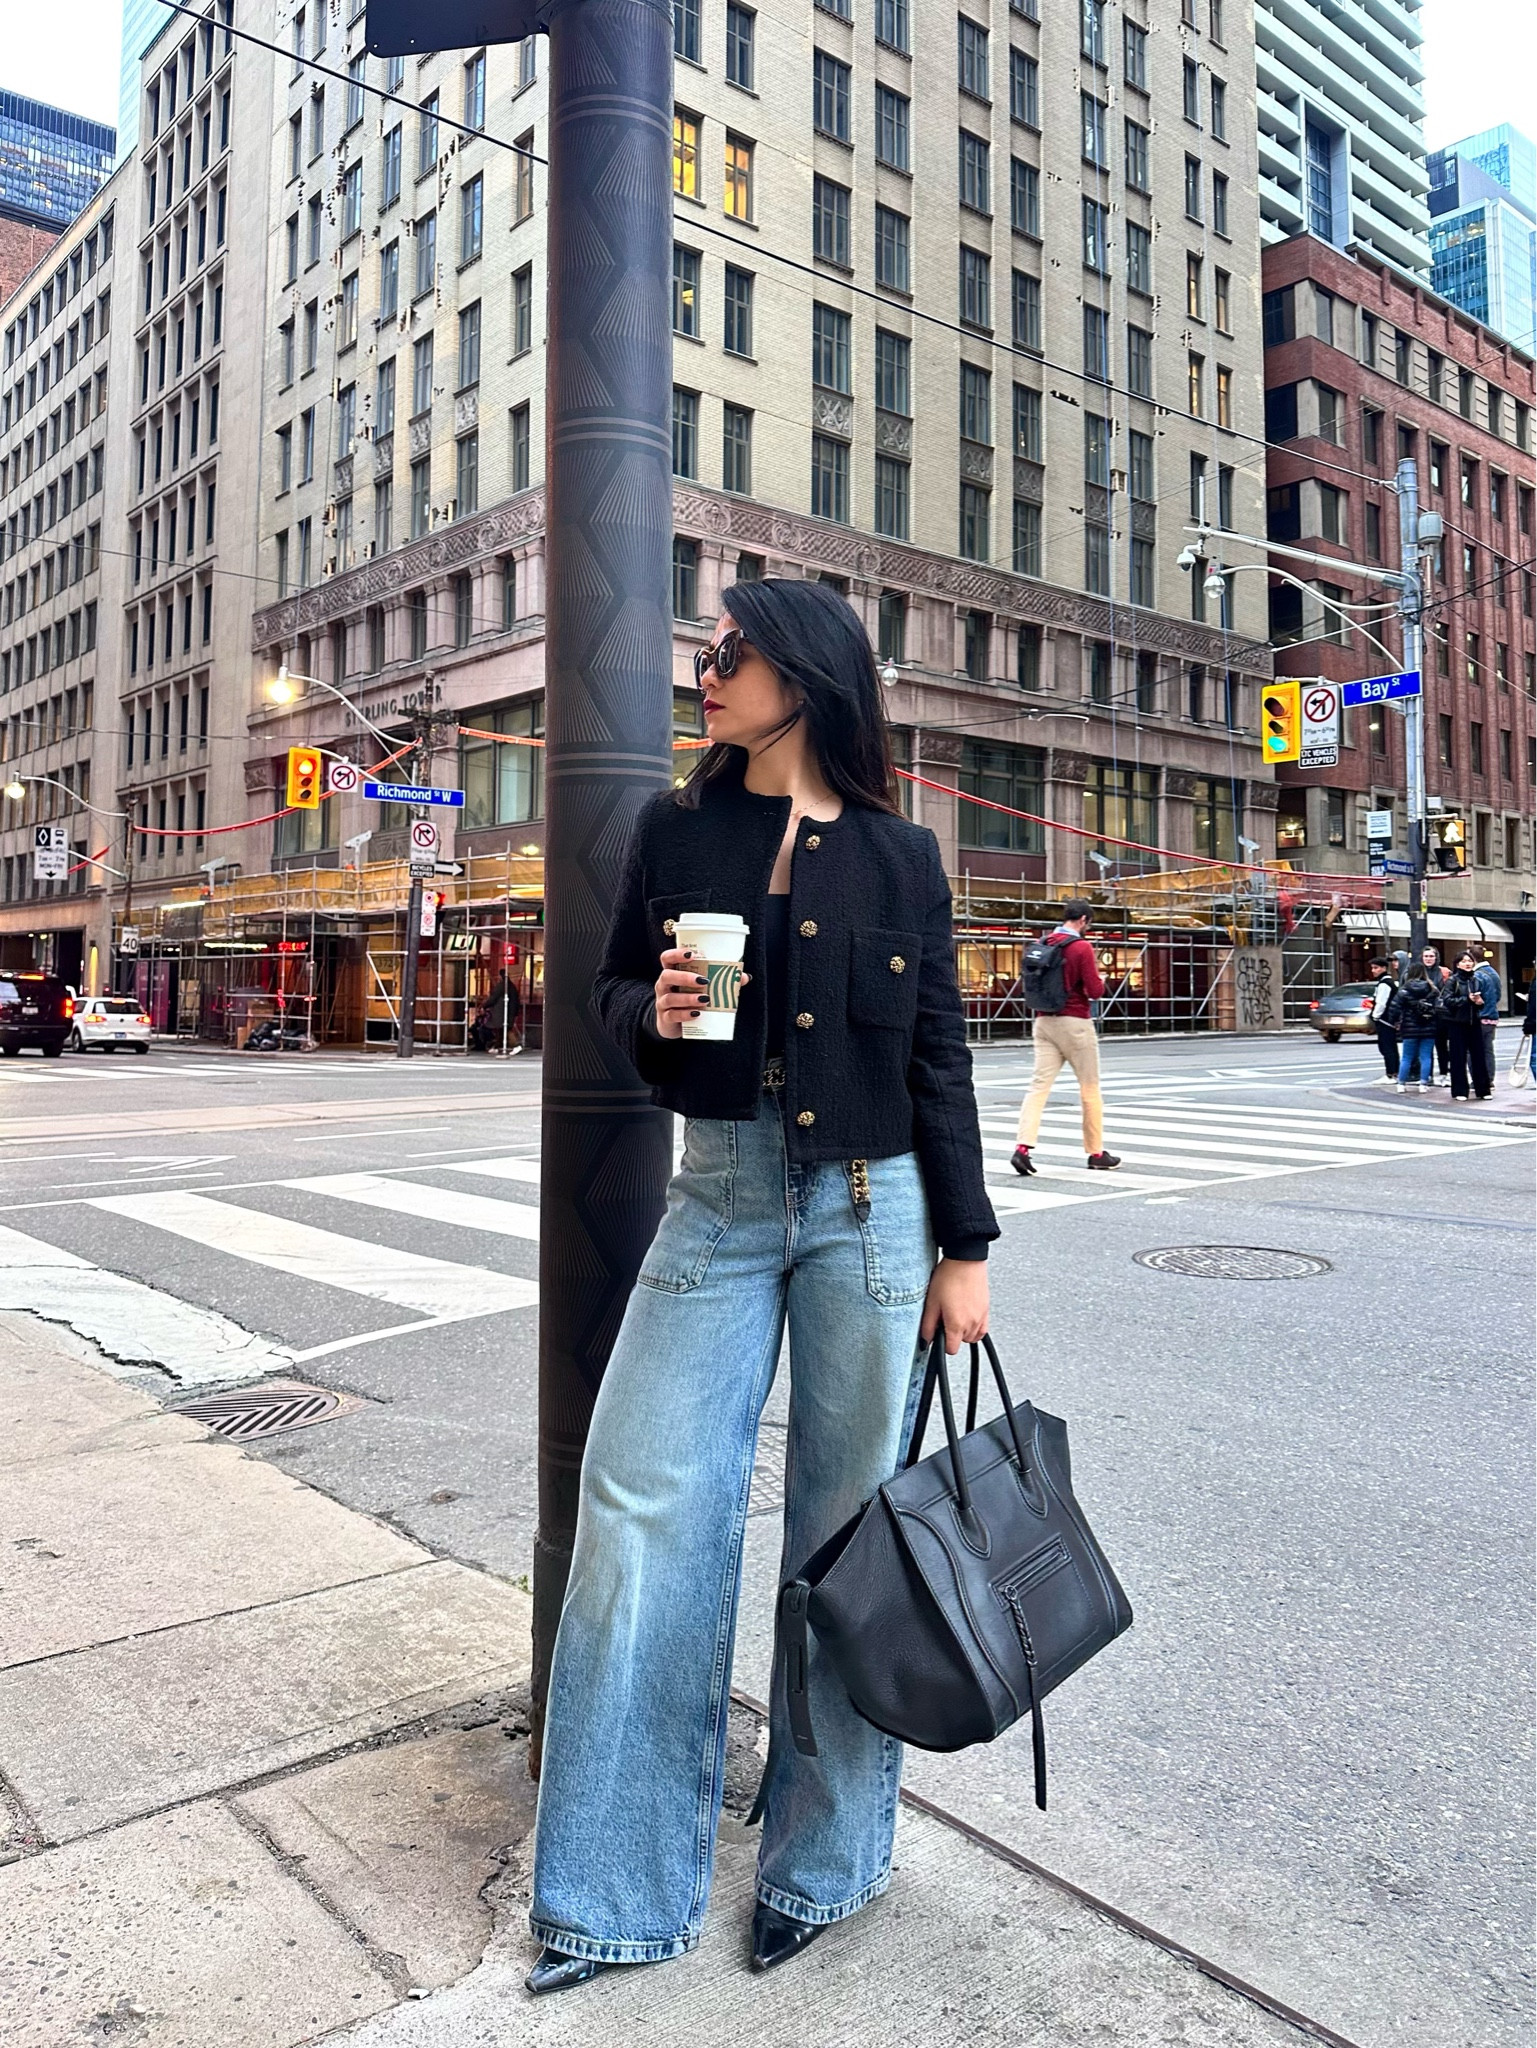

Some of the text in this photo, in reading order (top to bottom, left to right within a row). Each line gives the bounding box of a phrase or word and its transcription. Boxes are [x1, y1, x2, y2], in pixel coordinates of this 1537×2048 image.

[1361, 677, 1400, 699] Bay St
[402, 684, 442, 710] TOWR
[1312, 746, 1336, 757] VEHICLES
[1302, 756, 1335, 766] EXCEPTED
[377, 784, 432, 801] Richmond
[442, 791, 452, 803] W
[122, 938, 138, 950] 40
